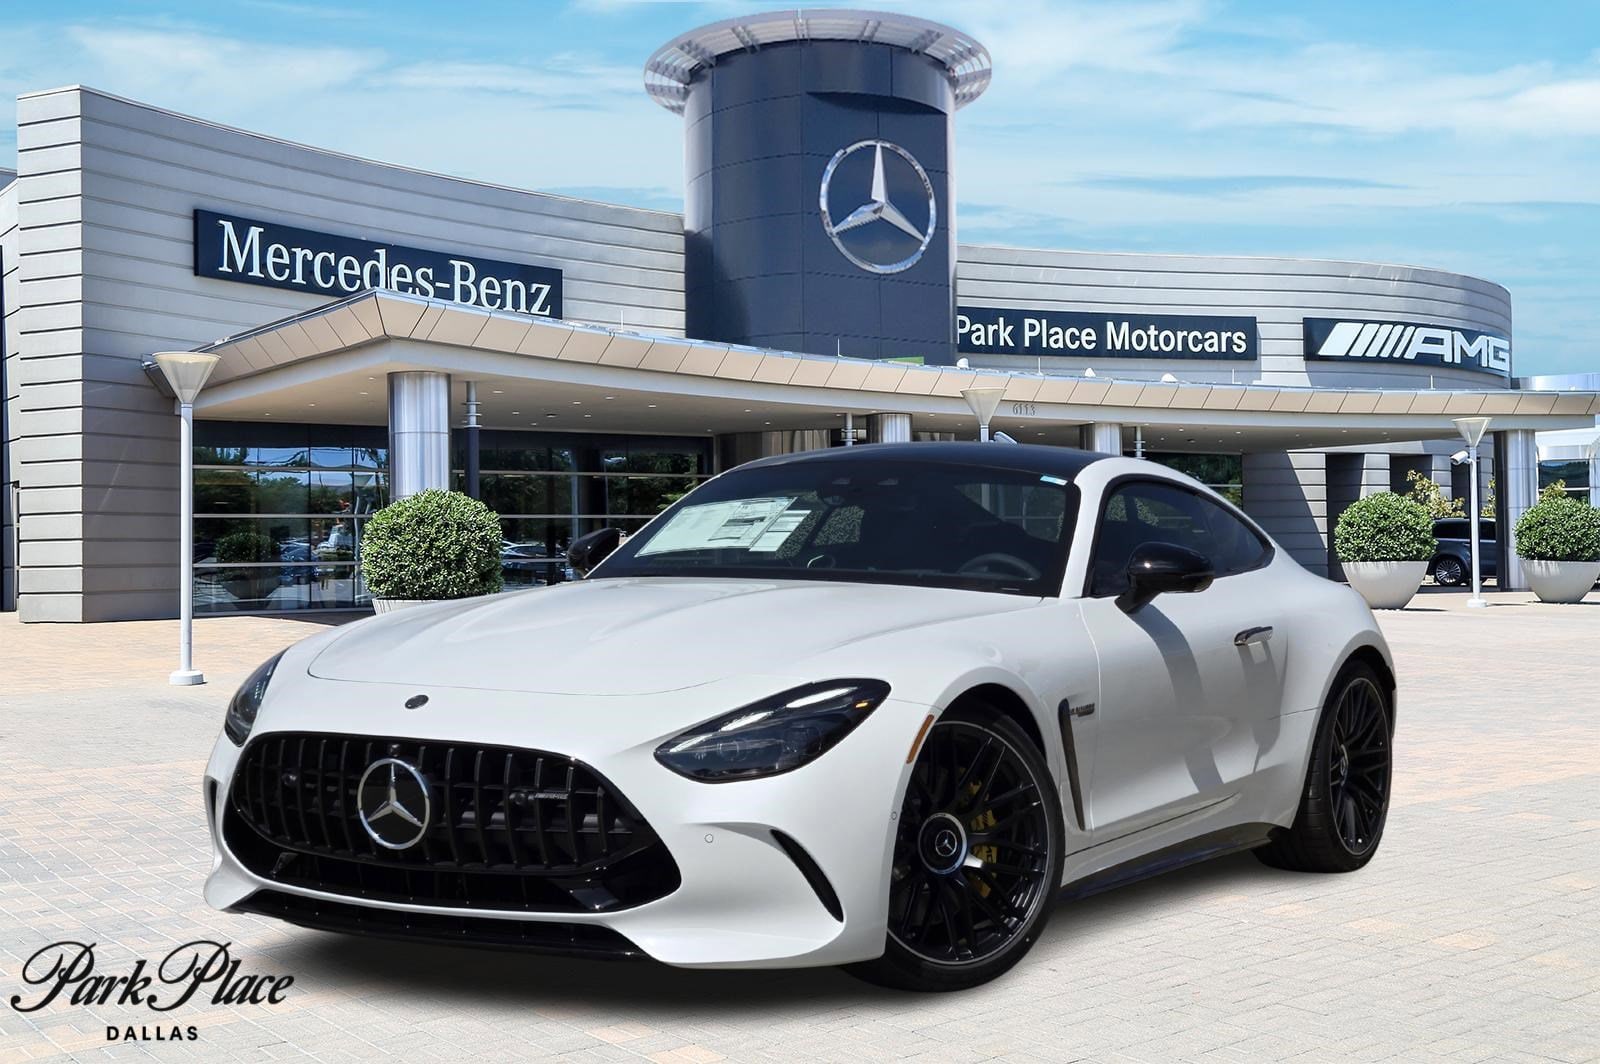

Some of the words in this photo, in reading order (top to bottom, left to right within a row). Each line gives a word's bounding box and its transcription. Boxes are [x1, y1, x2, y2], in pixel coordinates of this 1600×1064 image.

[217, 219, 552, 316] Mercedes-Benz
[957, 315, 1015, 347] Park
[1024, 318, 1097, 350] Place
[1106, 321, 1248, 353] Motorcars
[1403, 327, 1510, 372] AMG
